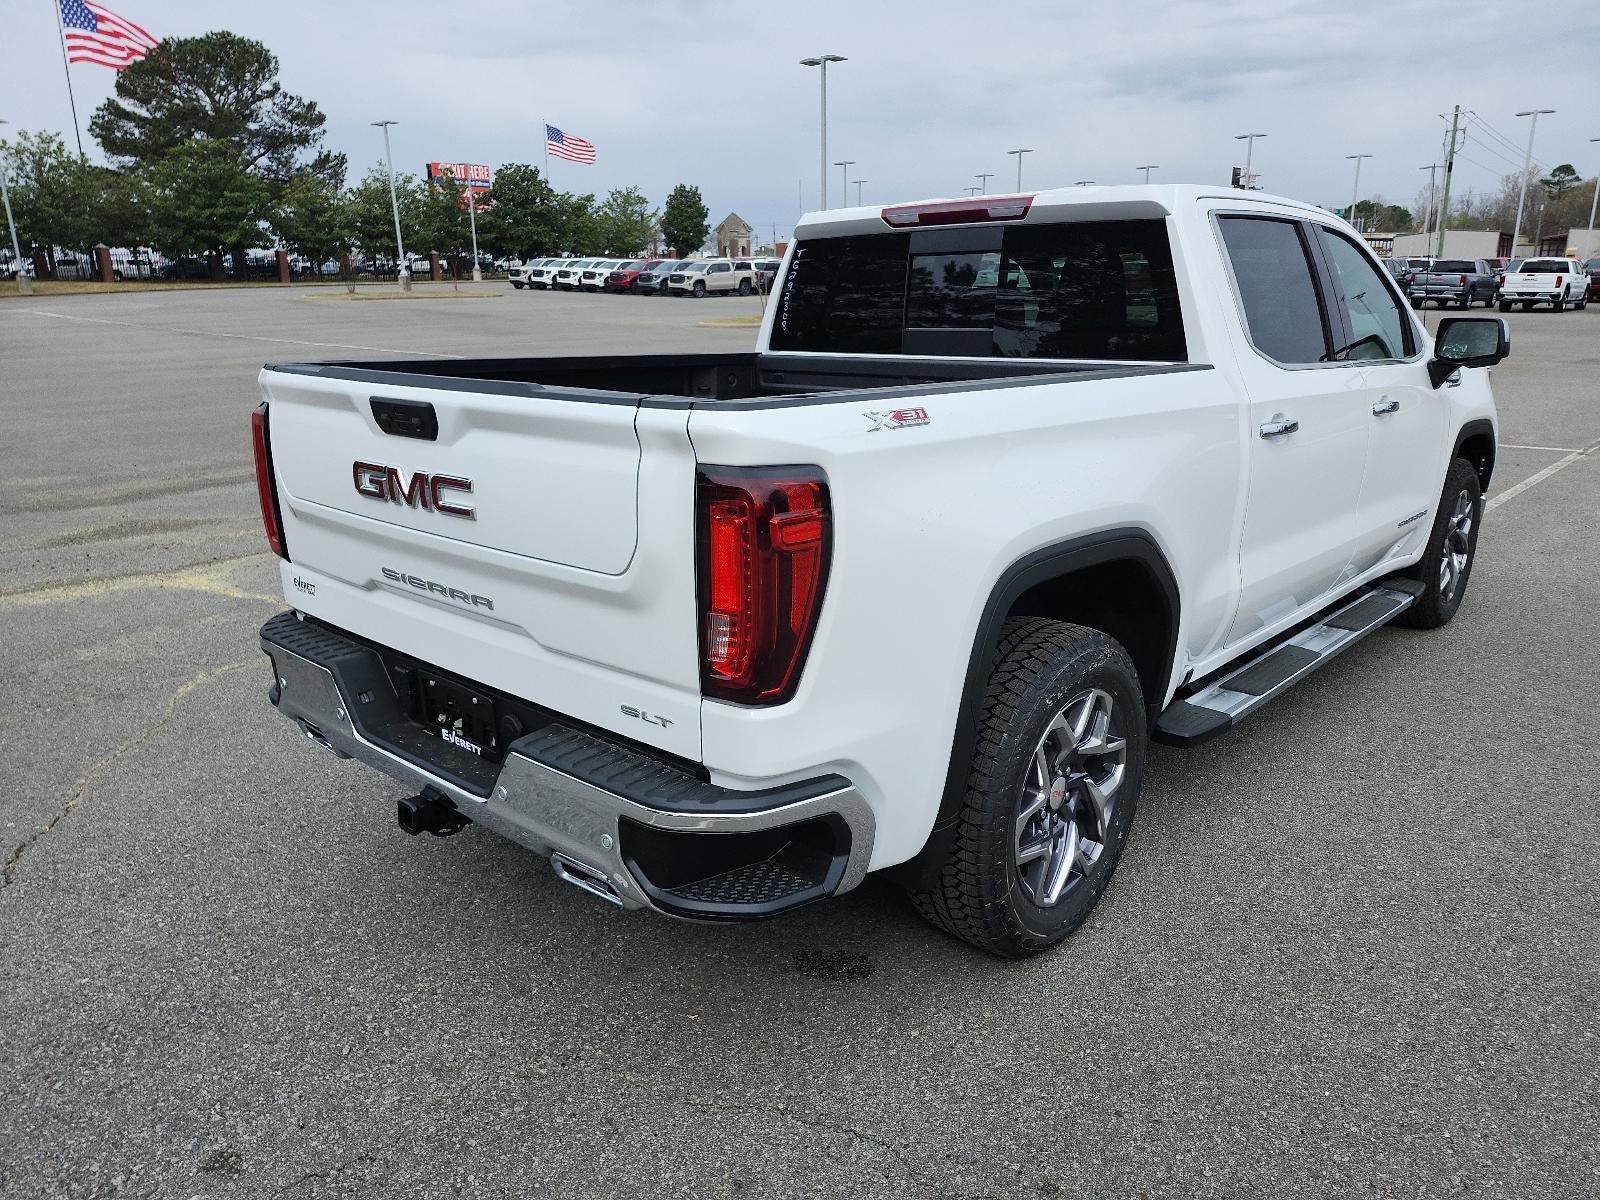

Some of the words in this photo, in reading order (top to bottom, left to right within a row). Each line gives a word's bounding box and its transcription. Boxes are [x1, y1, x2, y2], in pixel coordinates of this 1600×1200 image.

[469, 164, 489, 180] HERE
[352, 459, 477, 522] GMC
[381, 566, 495, 611] SIERRA
[620, 704, 675, 729] SLT
[441, 728, 482, 756] EVERETT
